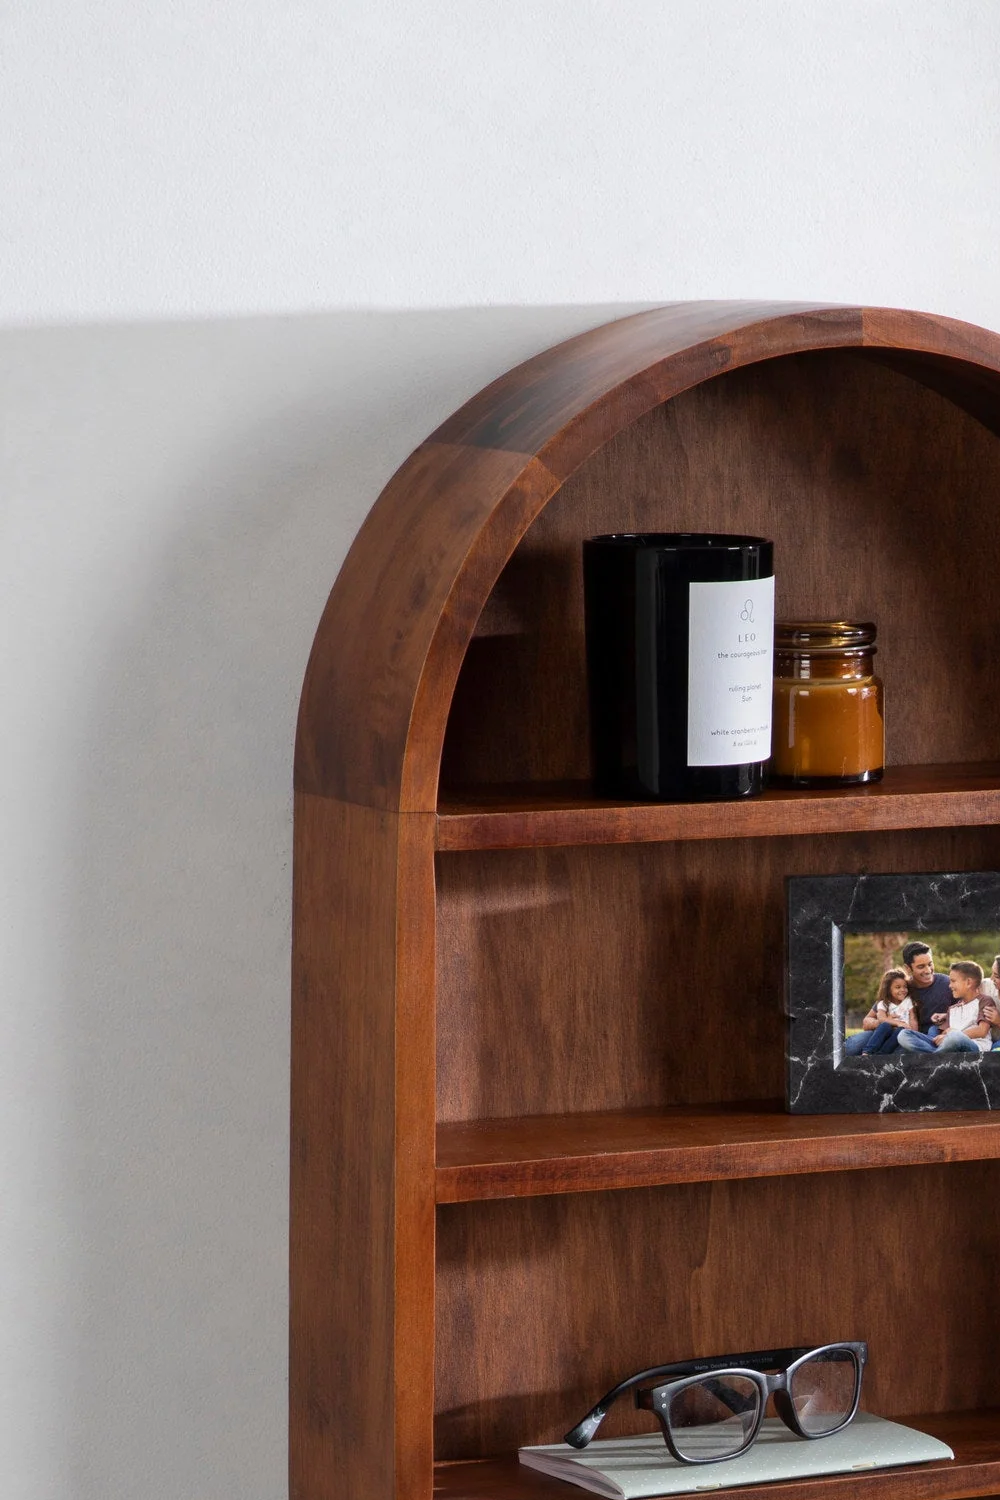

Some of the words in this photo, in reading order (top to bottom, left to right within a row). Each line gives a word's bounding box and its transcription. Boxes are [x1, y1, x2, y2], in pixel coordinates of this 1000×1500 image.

[738, 633, 756, 643] LEO
[717, 651, 729, 659] the
[710, 728, 730, 736] white
